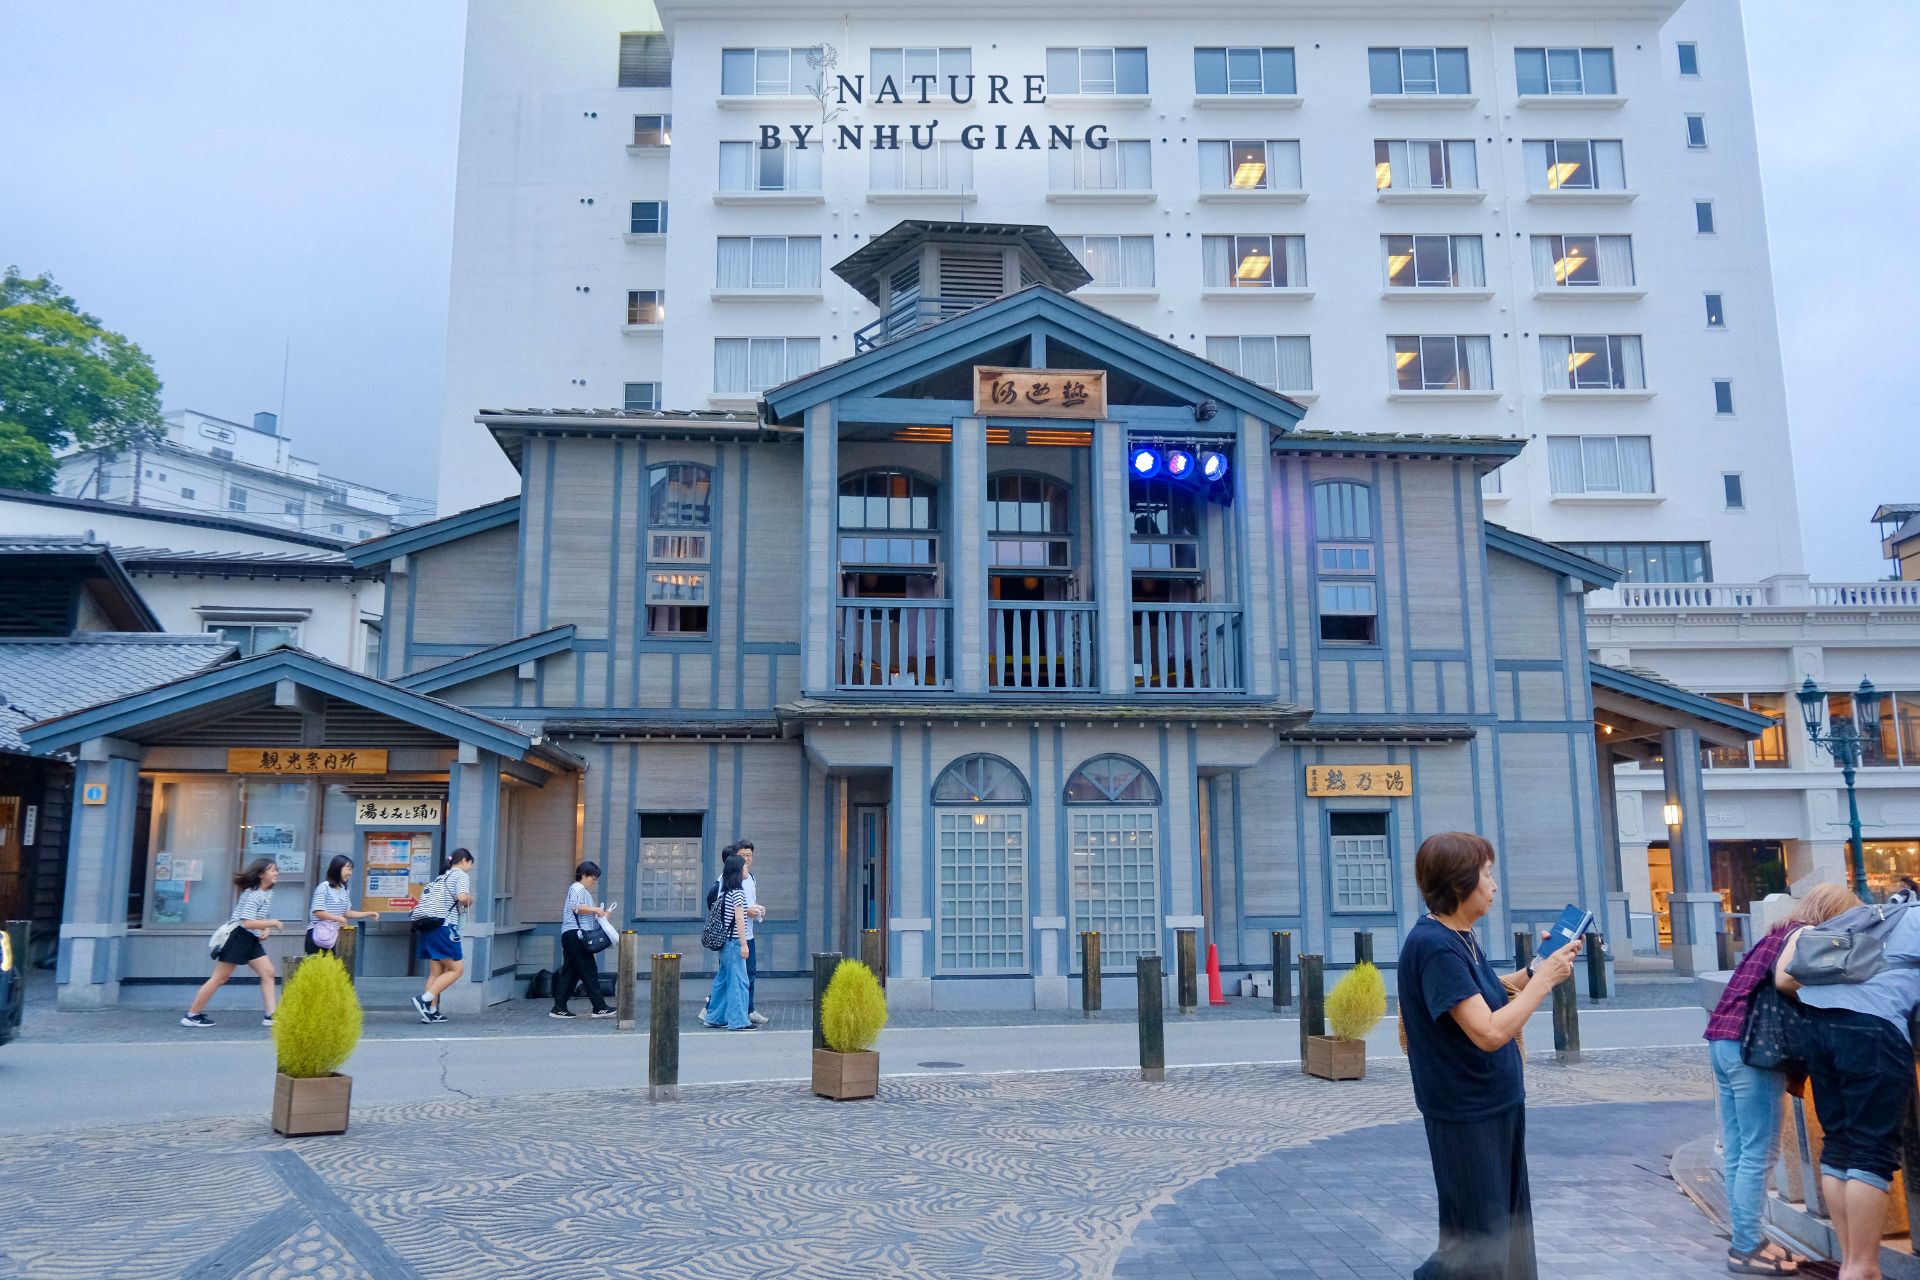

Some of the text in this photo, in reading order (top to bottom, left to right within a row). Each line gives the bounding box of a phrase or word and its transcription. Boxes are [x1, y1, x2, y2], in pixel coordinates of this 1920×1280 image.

[258, 750, 358, 771] 観光案内所
[360, 803, 438, 820] 湯もみと踊り
